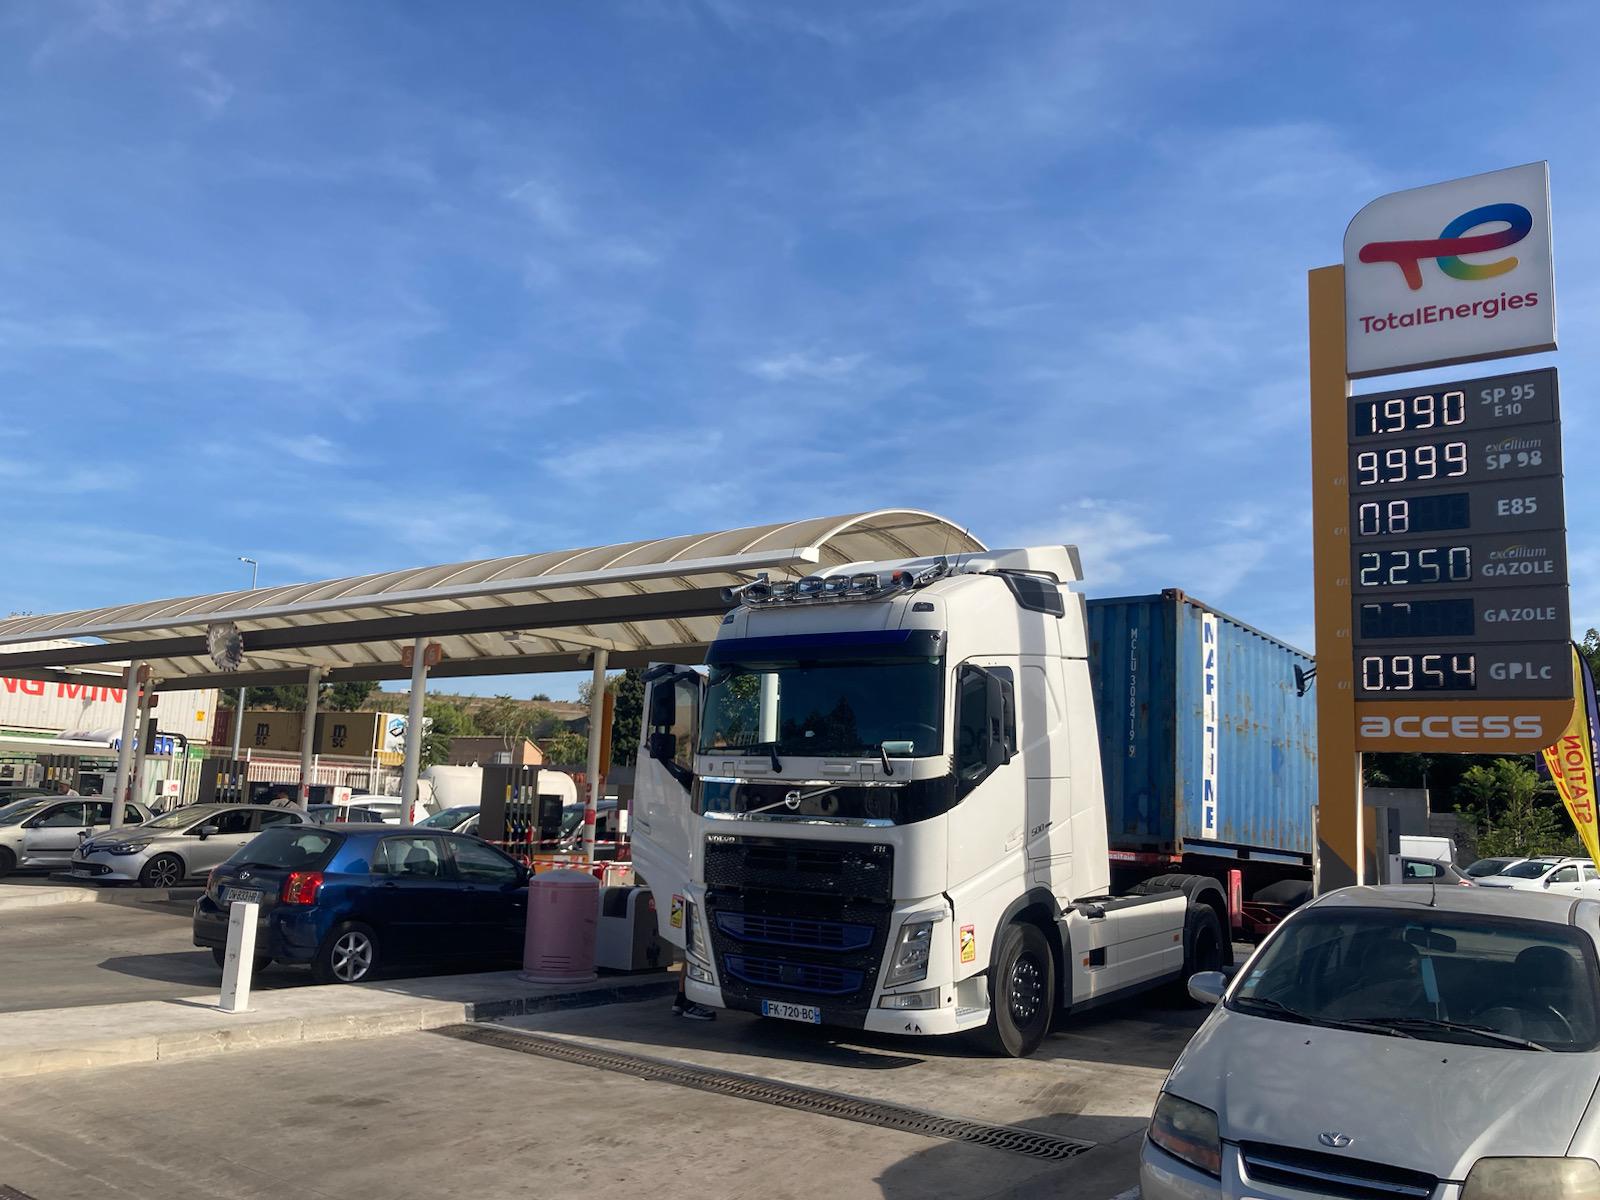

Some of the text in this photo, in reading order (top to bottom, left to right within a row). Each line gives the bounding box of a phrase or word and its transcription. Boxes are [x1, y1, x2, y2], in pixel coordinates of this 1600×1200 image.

[1360, 291, 1538, 334] TotalEnergies
[1480, 383, 1535, 405] SP 95
[1371, 390, 1466, 434] 1.990
[1486, 437, 1542, 453] excellium
[1358, 441, 1468, 486] 9.999
[1486, 450, 1542, 470] SP 98
[1497, 497, 1538, 516] E85
[1359, 500, 1410, 536] 0.8
[1489, 545, 1547, 560] excellium
[1360, 546, 1472, 587] 2.250
[1481, 560, 1554, 577] GAZOLE
[1483, 607, 1556, 623] GAZOLE
[1362, 655, 1476, 691] 0.954
[1489, 662, 1552, 681] GPLc
[707, 835, 736, 843] VOLVO
